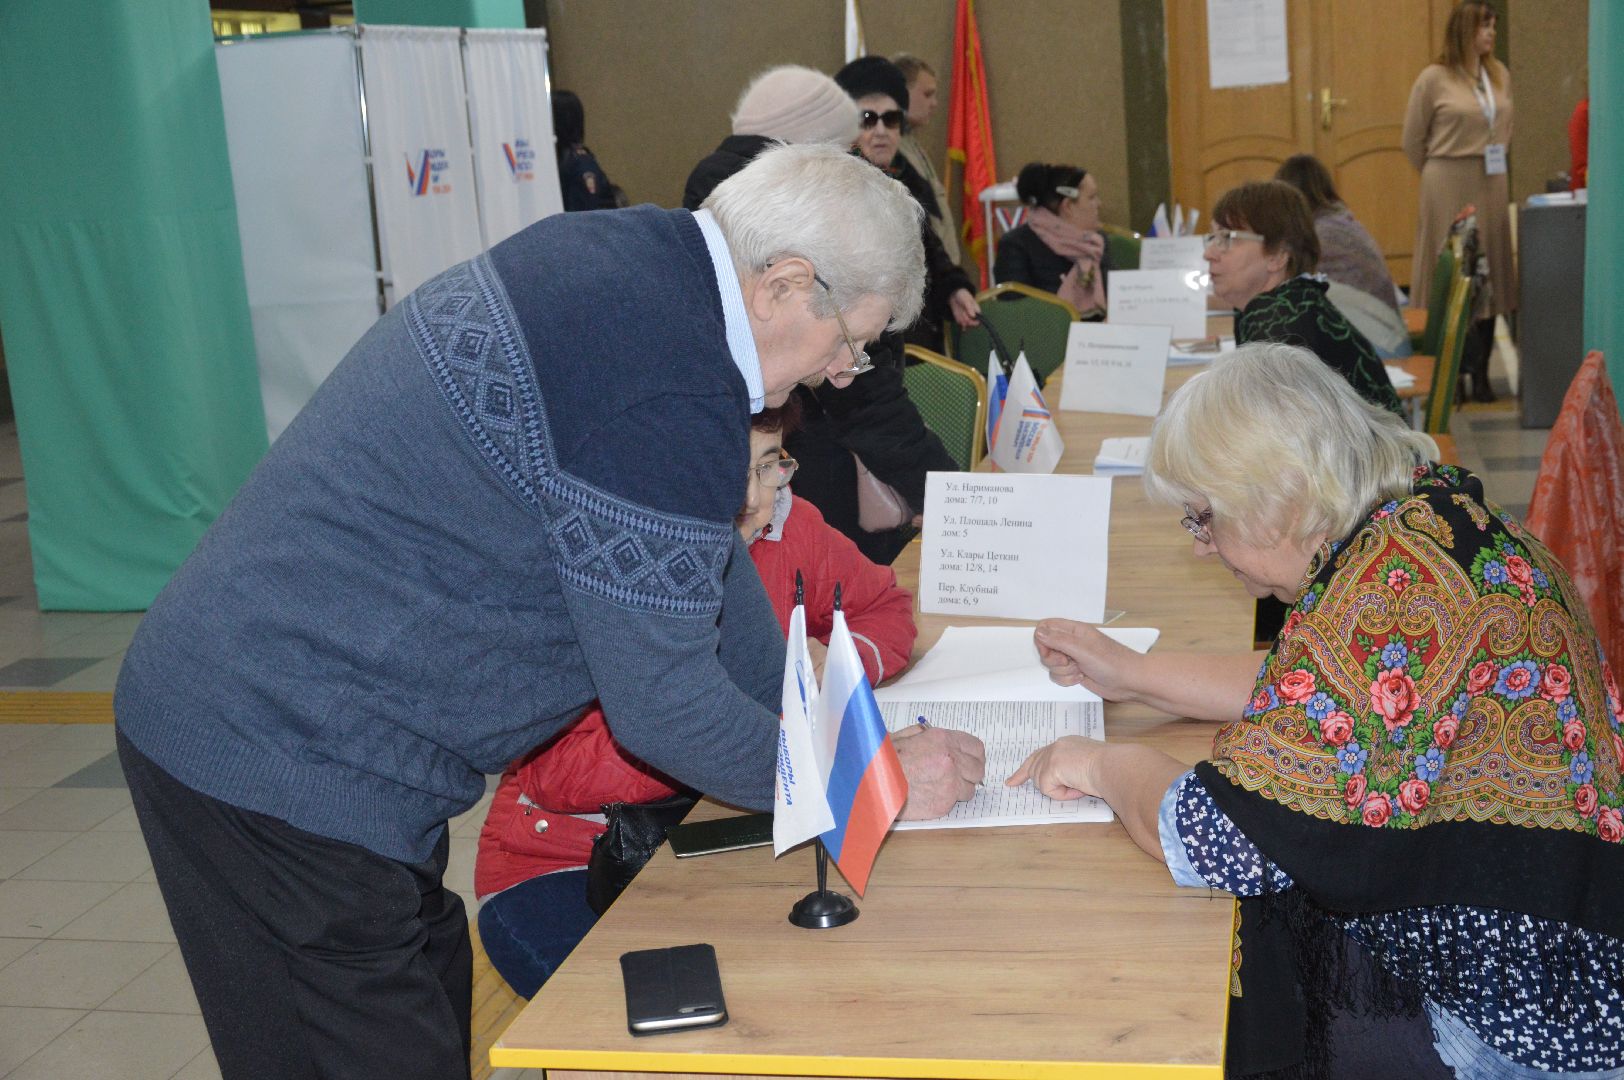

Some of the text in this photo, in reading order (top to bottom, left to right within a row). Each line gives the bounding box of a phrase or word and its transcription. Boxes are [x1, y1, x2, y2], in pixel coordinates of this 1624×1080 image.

[945, 481, 1014, 495] Ул. Нариманова
[944, 495, 998, 505] дома: 7/7, 10
[1000, 517, 1033, 528] Ленина
[962, 528, 969, 538] 5
[940, 549, 1020, 562] Ул. Клары Цеткин
[965, 562, 986, 573] 12/8,
[987, 563, 999, 573] 14
[938, 582, 999, 595] Пер. Клубный
[937, 596, 979, 605] дома: 6, 9
